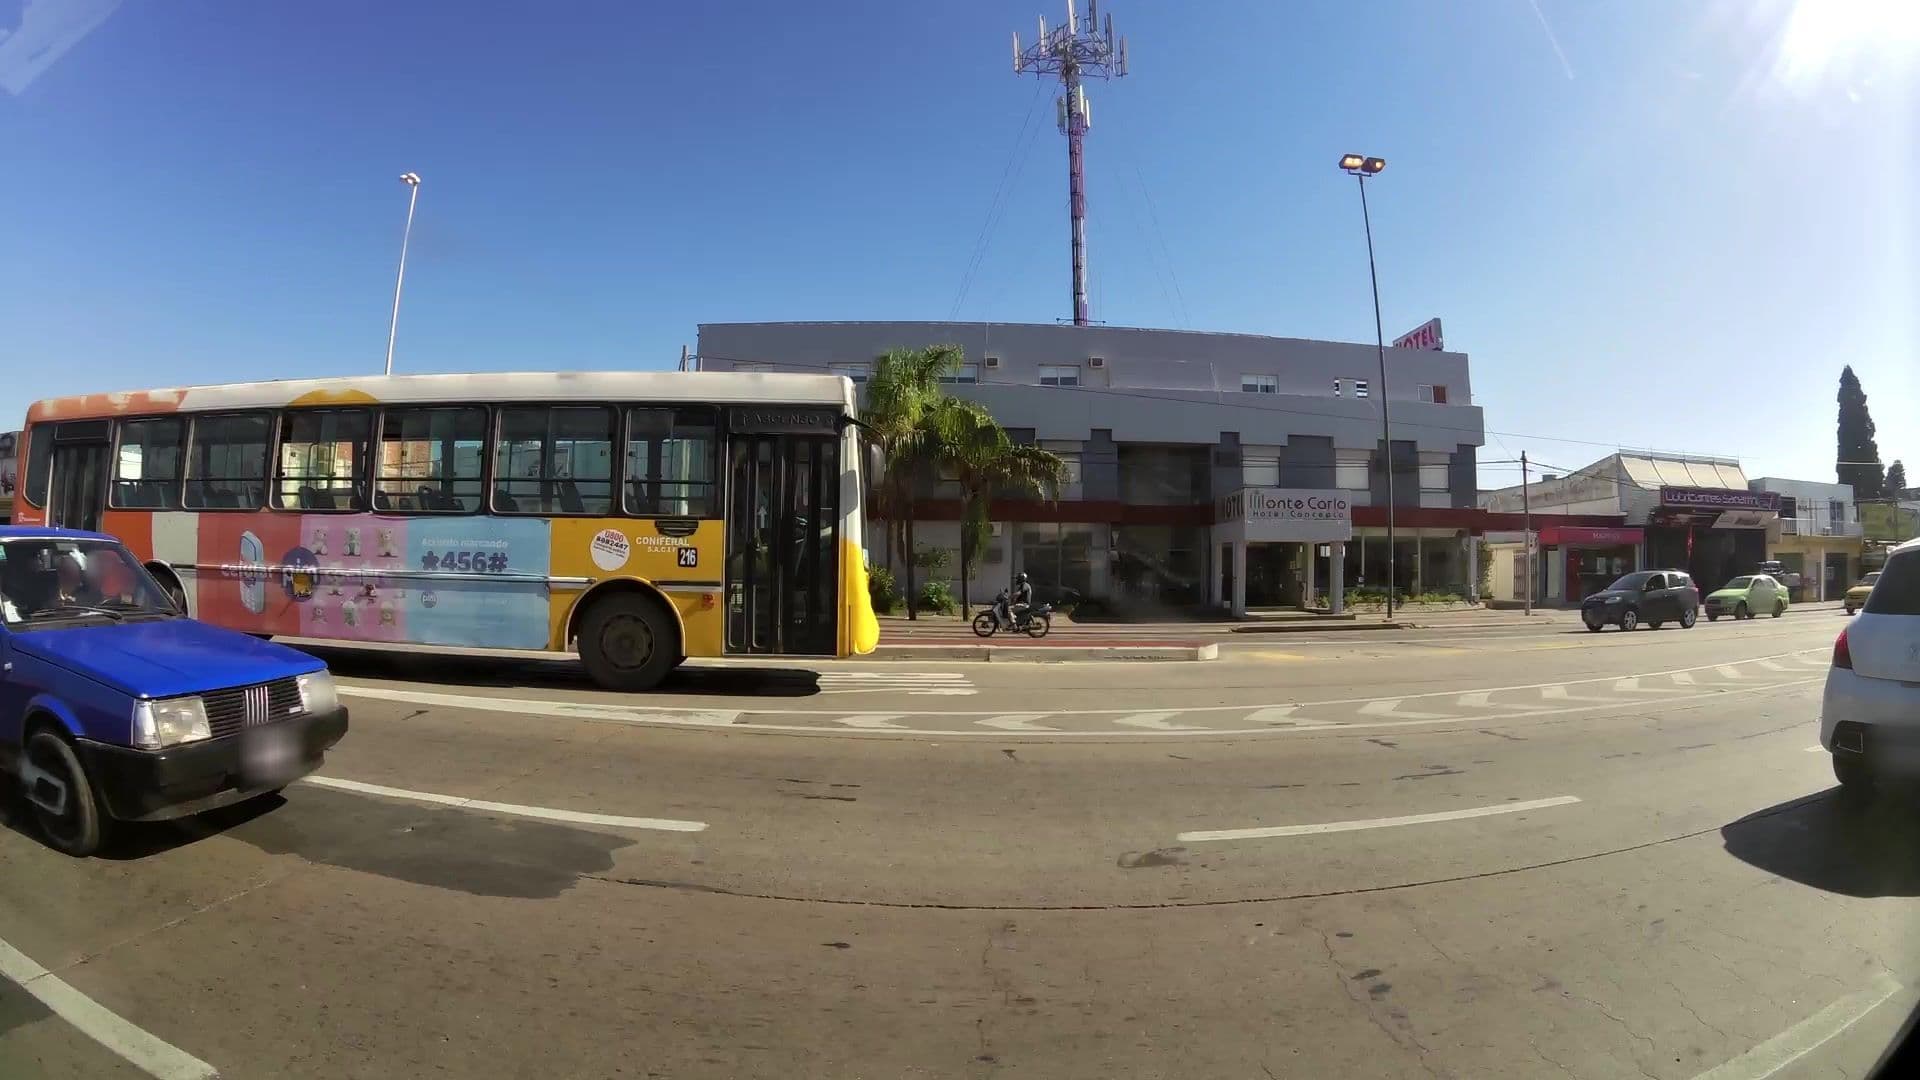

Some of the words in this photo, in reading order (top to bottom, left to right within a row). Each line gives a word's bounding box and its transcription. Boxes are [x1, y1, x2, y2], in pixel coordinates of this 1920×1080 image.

[1249, 493, 1304, 510] Monte
[1307, 496, 1347, 510] Carlo
[1252, 510, 1285, 518] Hotel
[1289, 510, 1344, 519] Concepto
[635, 536, 690, 547] CONIFERAL
[679, 549, 697, 566] 216
